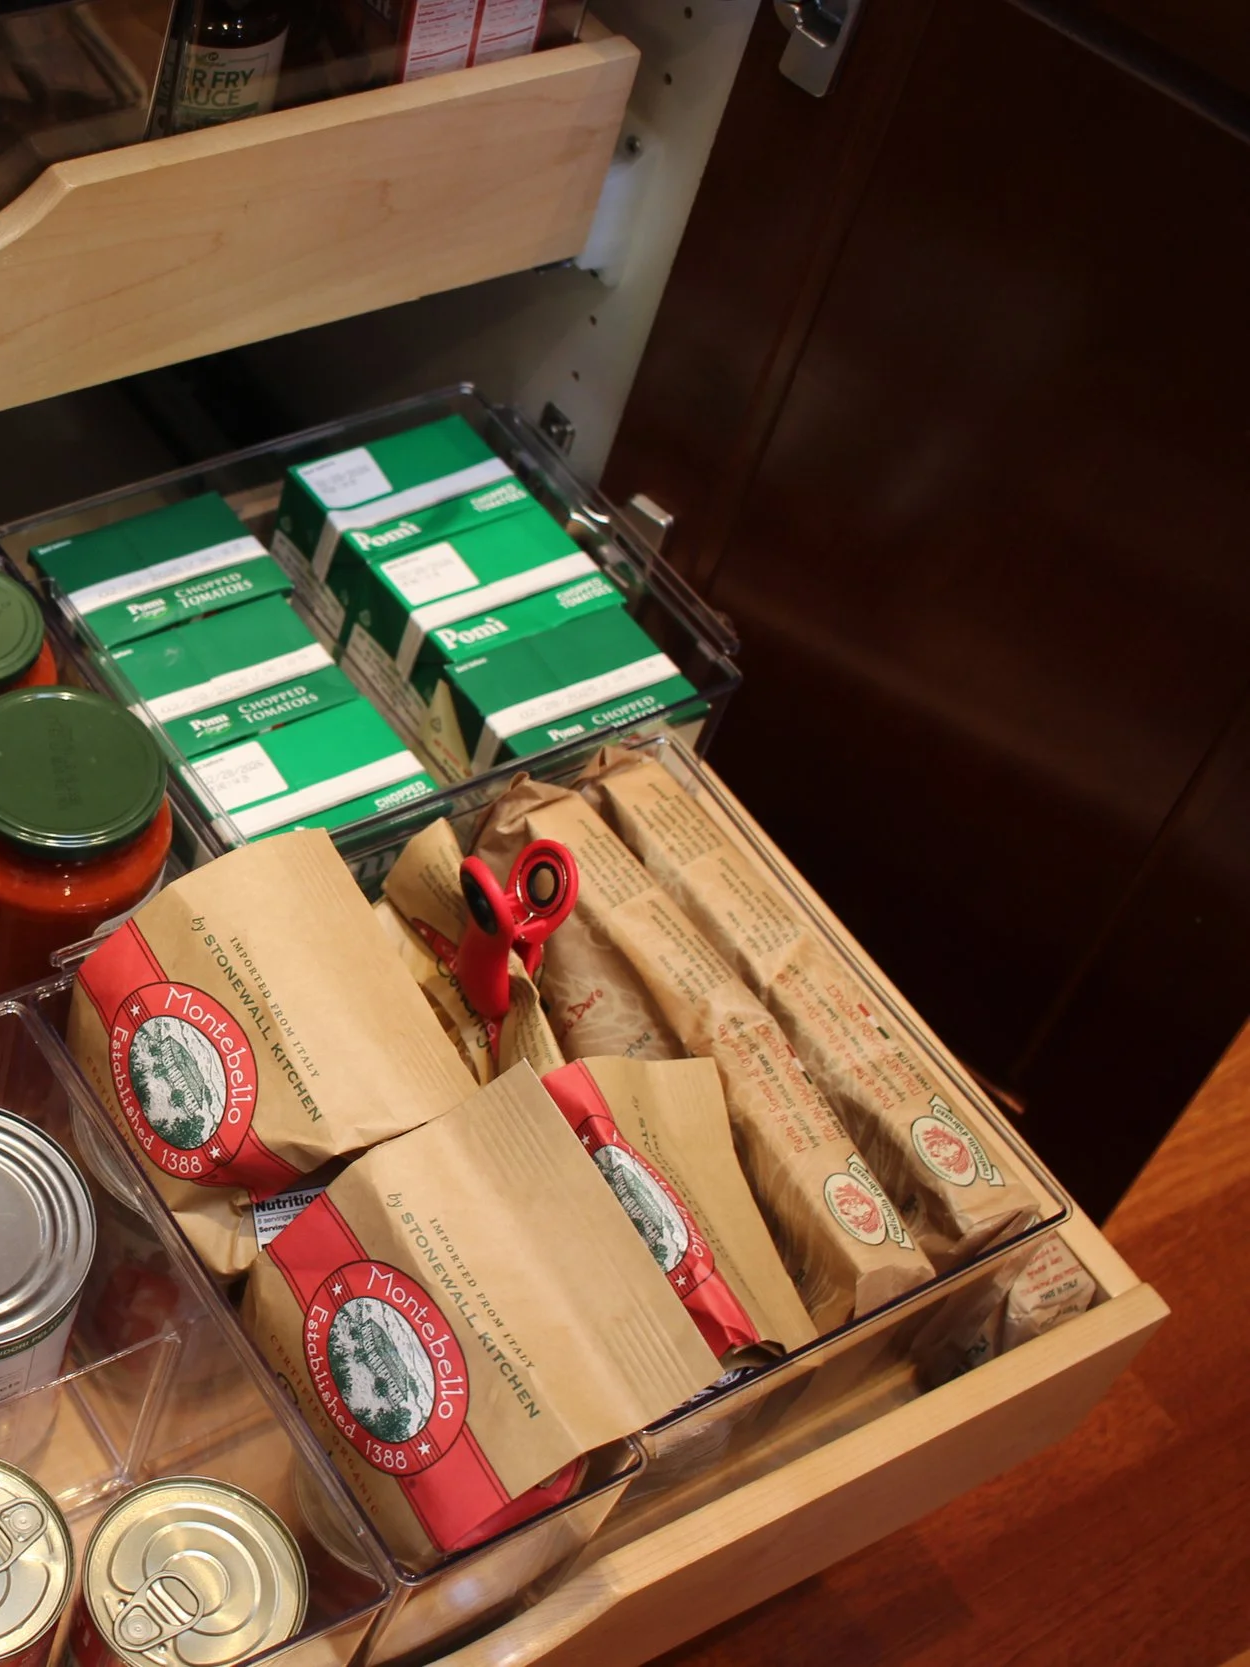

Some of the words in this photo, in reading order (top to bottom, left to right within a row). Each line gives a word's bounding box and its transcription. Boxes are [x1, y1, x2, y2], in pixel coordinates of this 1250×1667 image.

[212, 67, 255, 89] FRY
[173, 570, 243, 600] CHOPPED
[176, 578, 254, 610] TOMATOES
[236, 685, 308, 715] CHOPPED
[240, 691, 320, 725] TOMATOES
[588, 694, 658, 727] CHOPPED
[371, 779, 428, 809] CHOPPED
[164, 986, 252, 1124] Montebello
[190, 917, 206, 932] by
[204, 934, 271, 1041] STONEWALL
[270, 1042, 322, 1122] KITCHEN
[230, 937, 271, 999] IMPORTED
[265, 1003, 295, 1037] FROM
[292, 1041, 320, 1077] ITALY
[112, 1026, 155, 1150] Established
[162, 1149, 202, 1173] 1388
[366, 1265, 464, 1419] Montebello
[386, 1193, 403, 1208] by
[400, 1212, 477, 1331] STONEWALL
[478, 1332, 540, 1419] KITCHEN
[429, 1218, 477, 1288] IMPORTED
[476, 1293, 504, 1328] FROM
[503, 1333, 535, 1368] ITALY
[306, 1304, 356, 1438] Established
[365, 1439, 407, 1469] 1388
